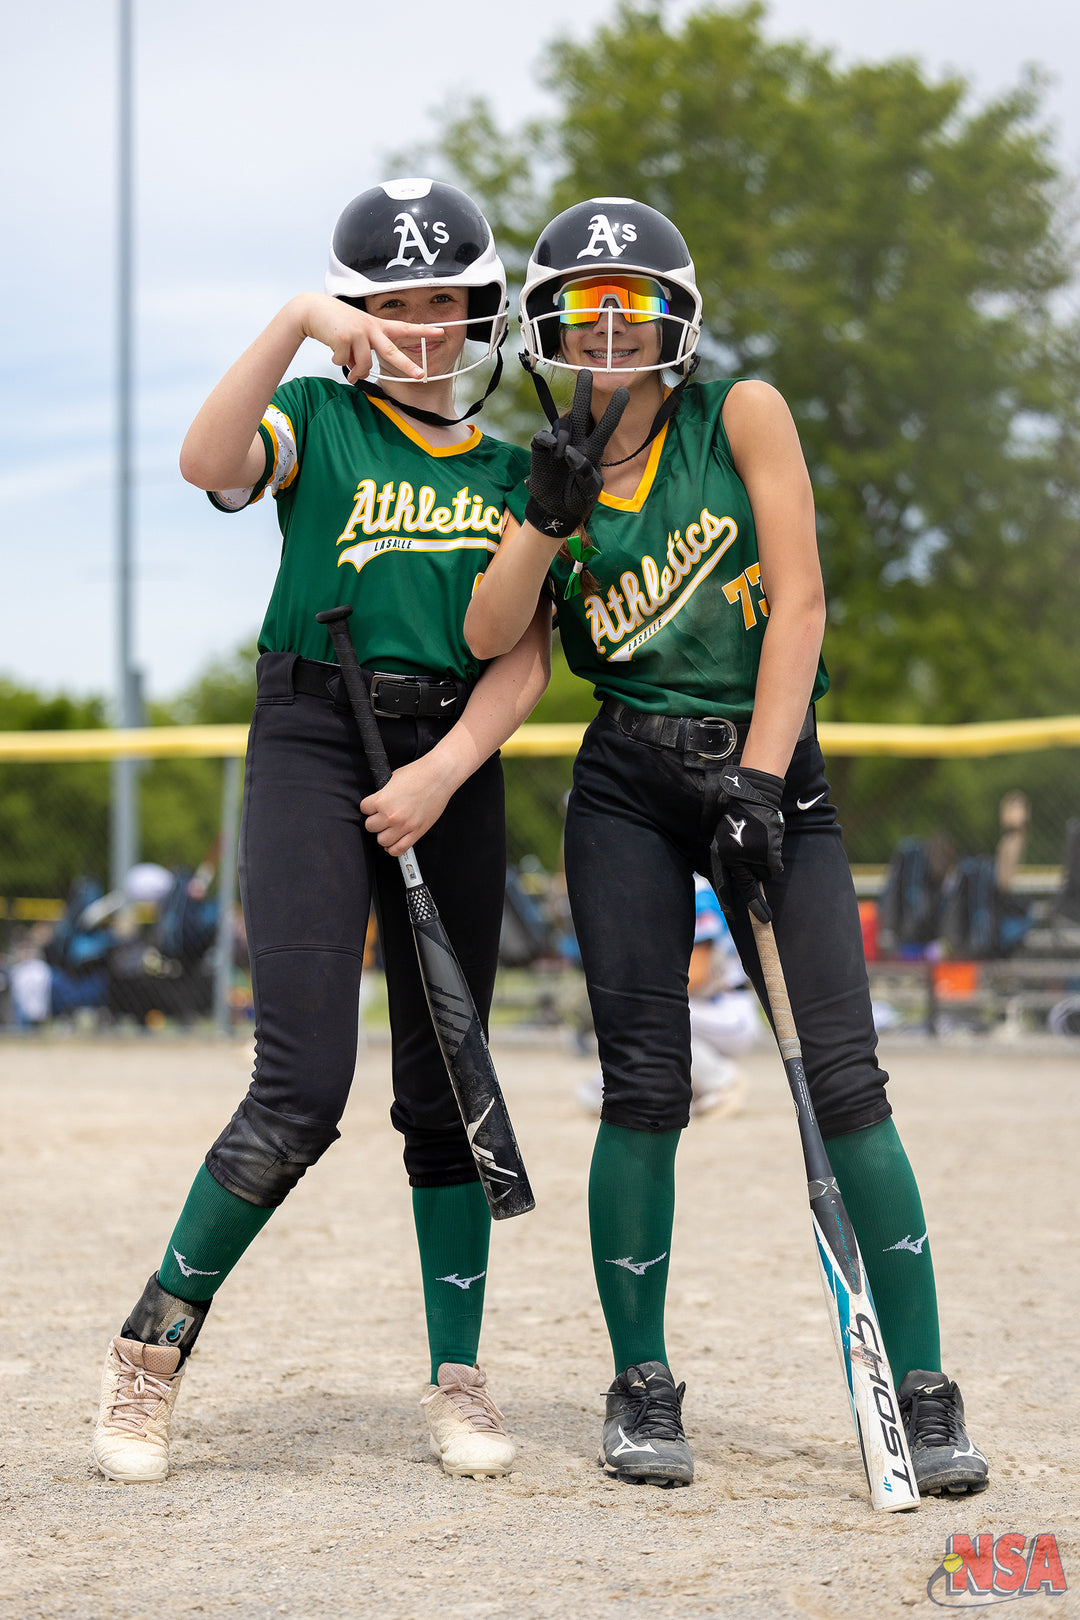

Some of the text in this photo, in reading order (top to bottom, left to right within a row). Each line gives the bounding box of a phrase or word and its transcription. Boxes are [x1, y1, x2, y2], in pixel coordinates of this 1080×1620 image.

[336, 478, 504, 546] Athletic
[374, 538, 413, 552] LASALLE
[584, 508, 738, 654] Athletics
[628, 618, 662, 652] LASALLE
[849, 1313, 915, 1499] GHOST
